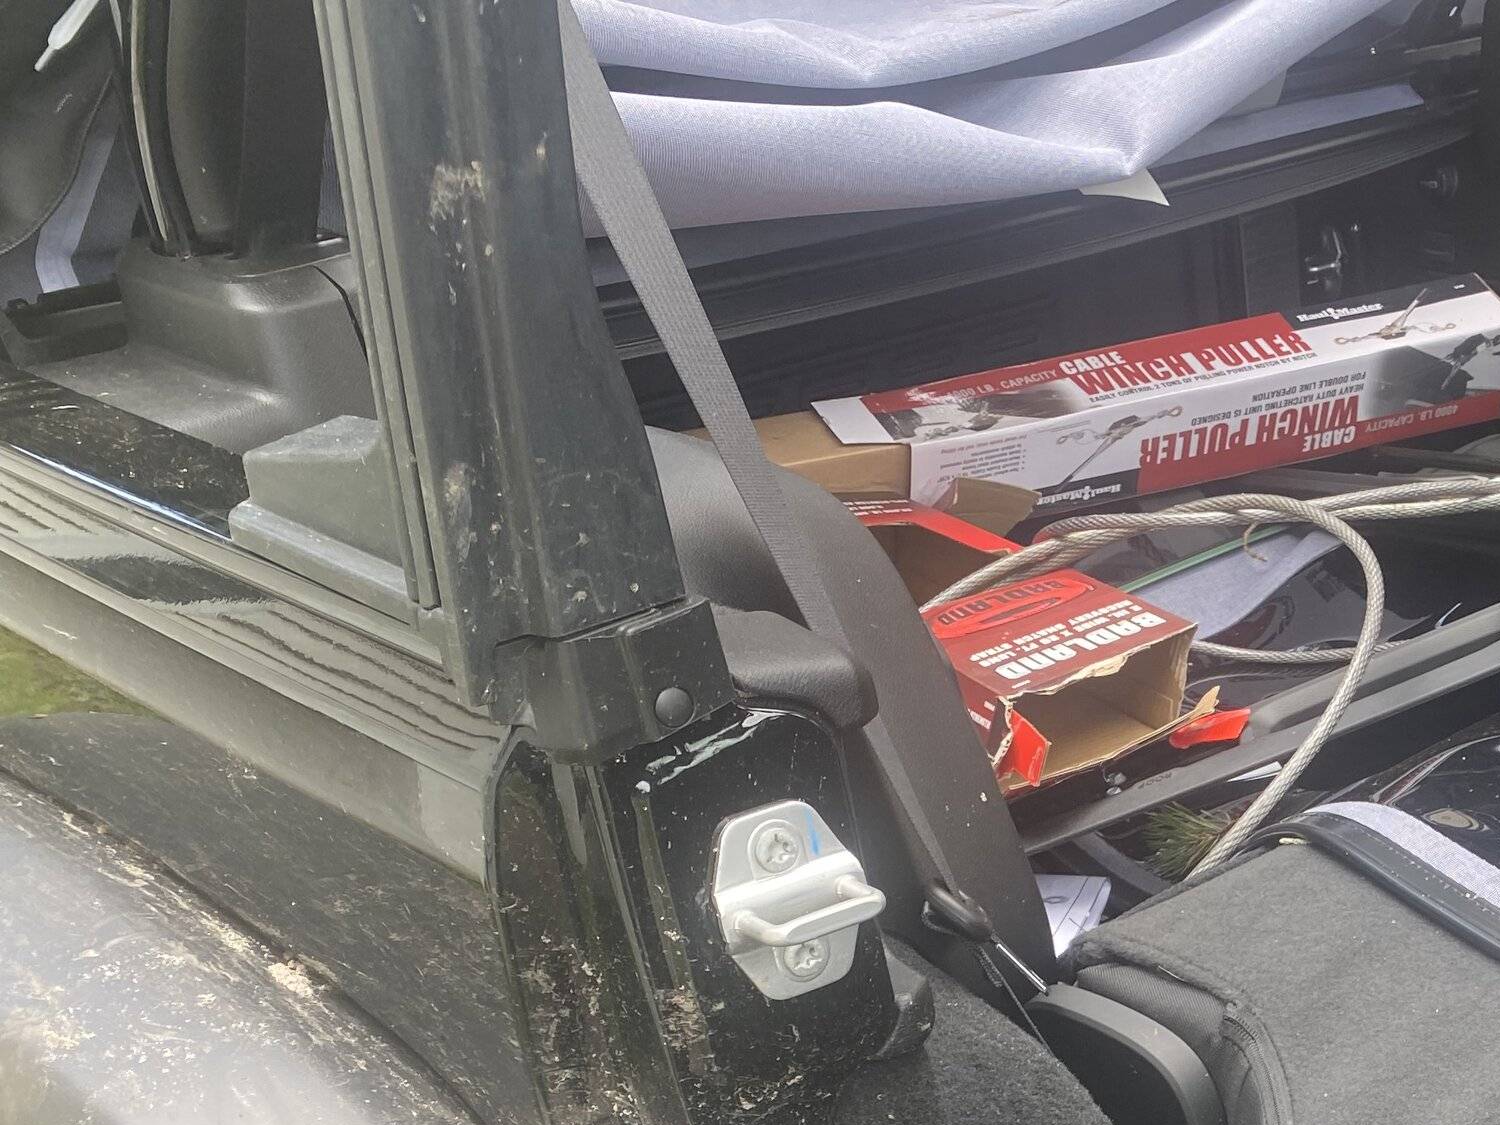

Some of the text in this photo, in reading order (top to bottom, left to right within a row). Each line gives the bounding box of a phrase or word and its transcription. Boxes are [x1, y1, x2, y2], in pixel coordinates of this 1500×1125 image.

[1001, 368, 1057, 390] CAPACITY
[1058, 350, 1125, 376] CABLE
[1068, 331, 1312, 396] WINCH PULLER
[1162, 379, 1183, 388] TONS
[1183, 377, 1193, 385] OF
[1195, 370, 1226, 382] PULLING
[1227, 366, 1254, 376] POWER
[1255, 360, 1280, 370] NOTCH
[1281, 357, 1292, 365] BY
[1293, 352, 1318, 362] NOTCH
[1252, 371, 1367, 402] FOR DOUBLE LINE OPERATION
[1191, 382, 1364, 427] HEAVY DUTY RATCHETING UNIT IS DESIGNED
[1140, 394, 1359, 466] WINCH PULLER
[1302, 425, 1356, 453] CABLE
[1365, 412, 1414, 433] CAPACITY
[937, 579, 1065, 626] BADLAND
[969, 643, 1013, 662] STRAP
[994, 611, 1167, 680] BADLAND
